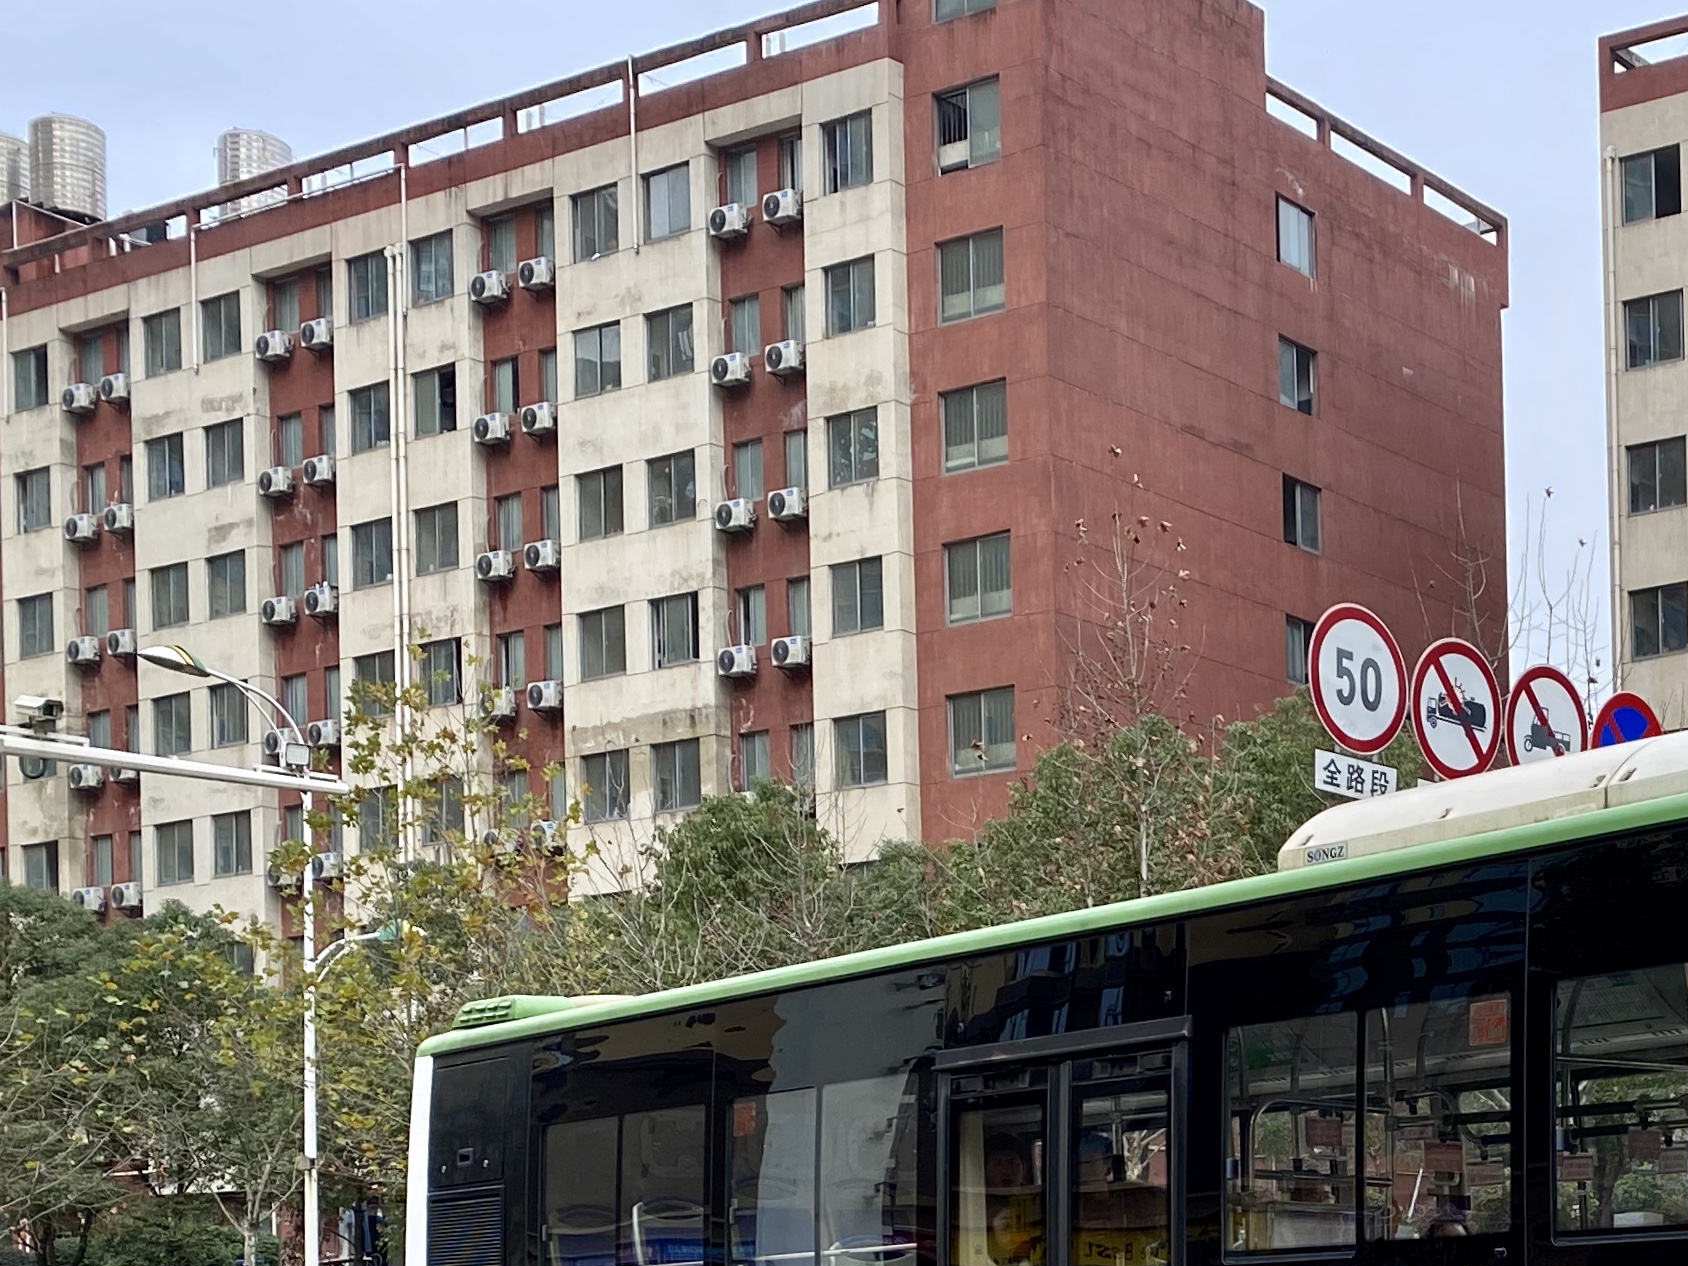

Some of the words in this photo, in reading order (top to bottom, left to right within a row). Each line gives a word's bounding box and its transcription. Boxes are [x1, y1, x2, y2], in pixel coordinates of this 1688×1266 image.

[1336, 647, 1382, 712] 50
[1323, 758, 1389, 797] 全路段
[1307, 845, 1345, 863] SONGZ
